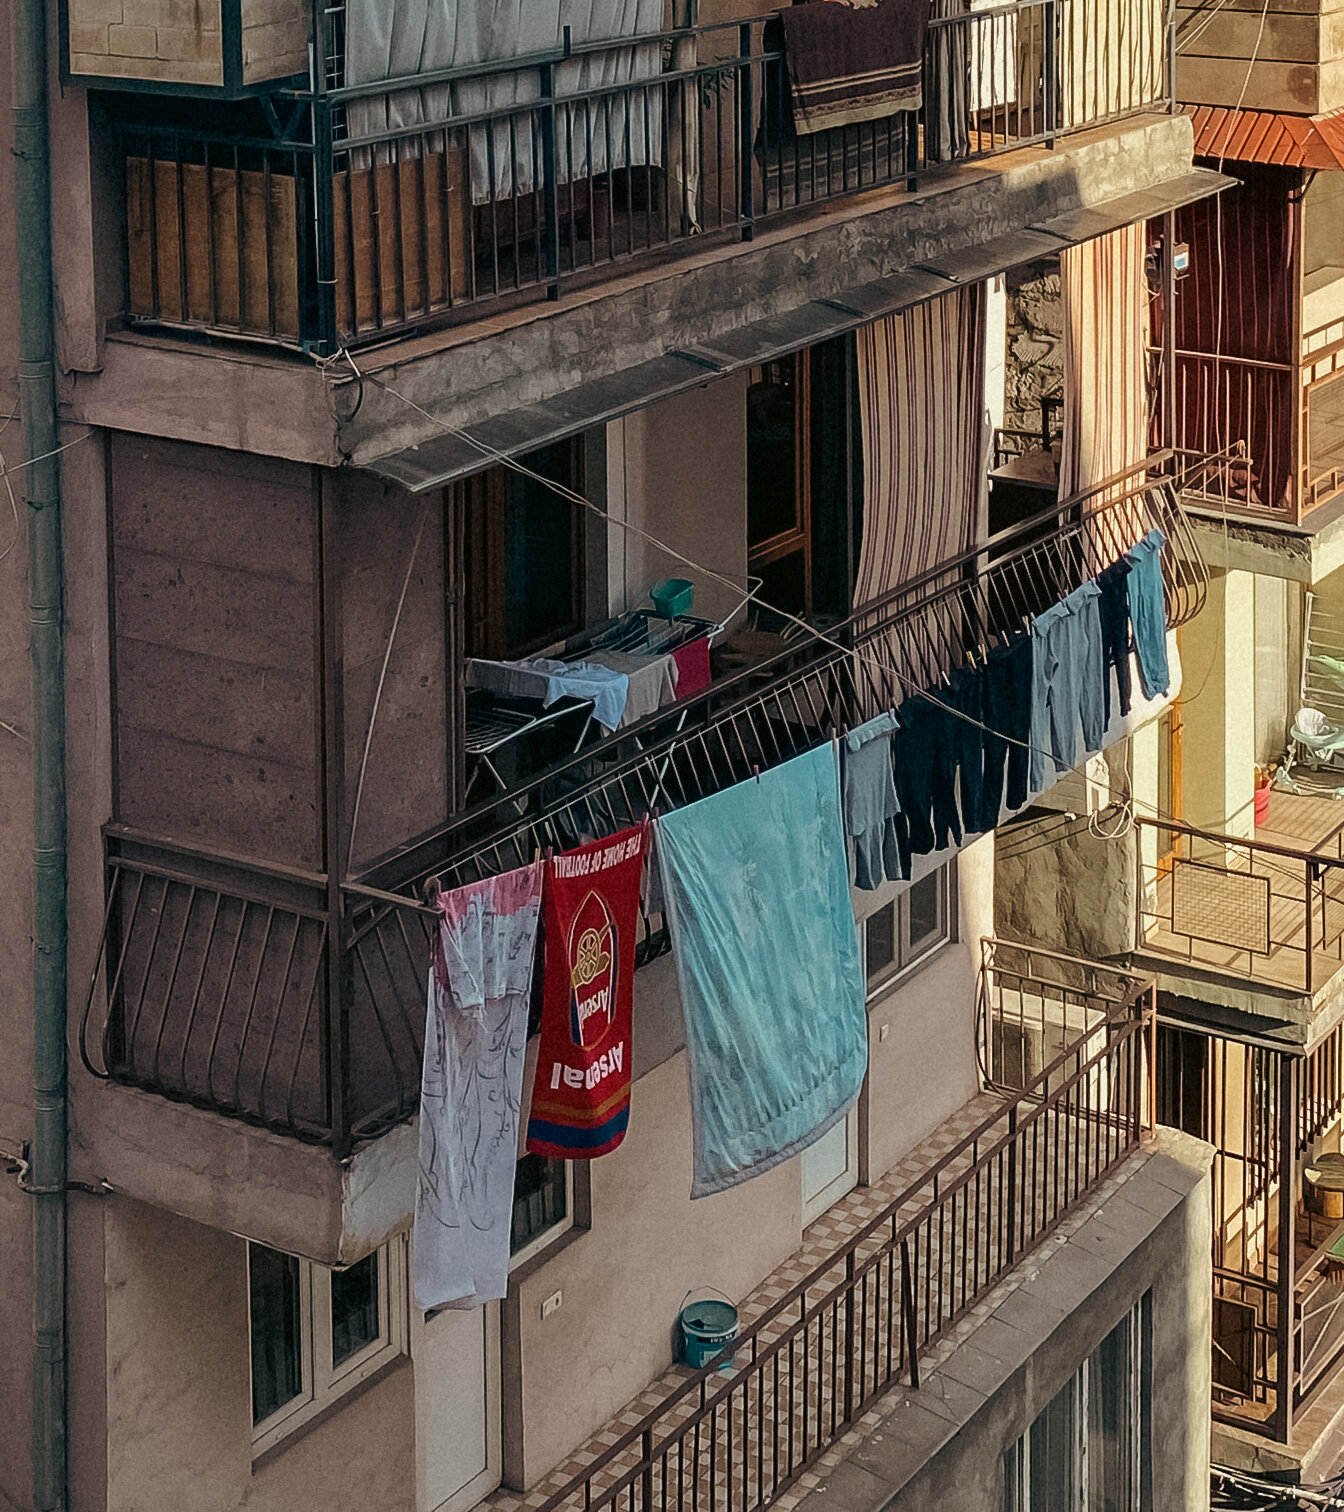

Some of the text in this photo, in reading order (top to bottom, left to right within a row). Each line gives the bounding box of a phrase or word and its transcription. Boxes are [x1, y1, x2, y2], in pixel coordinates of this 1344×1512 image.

[553, 832, 641, 878] THE HOME OF FOOTBALL
[550, 1041, 624, 1090] Arsenal
